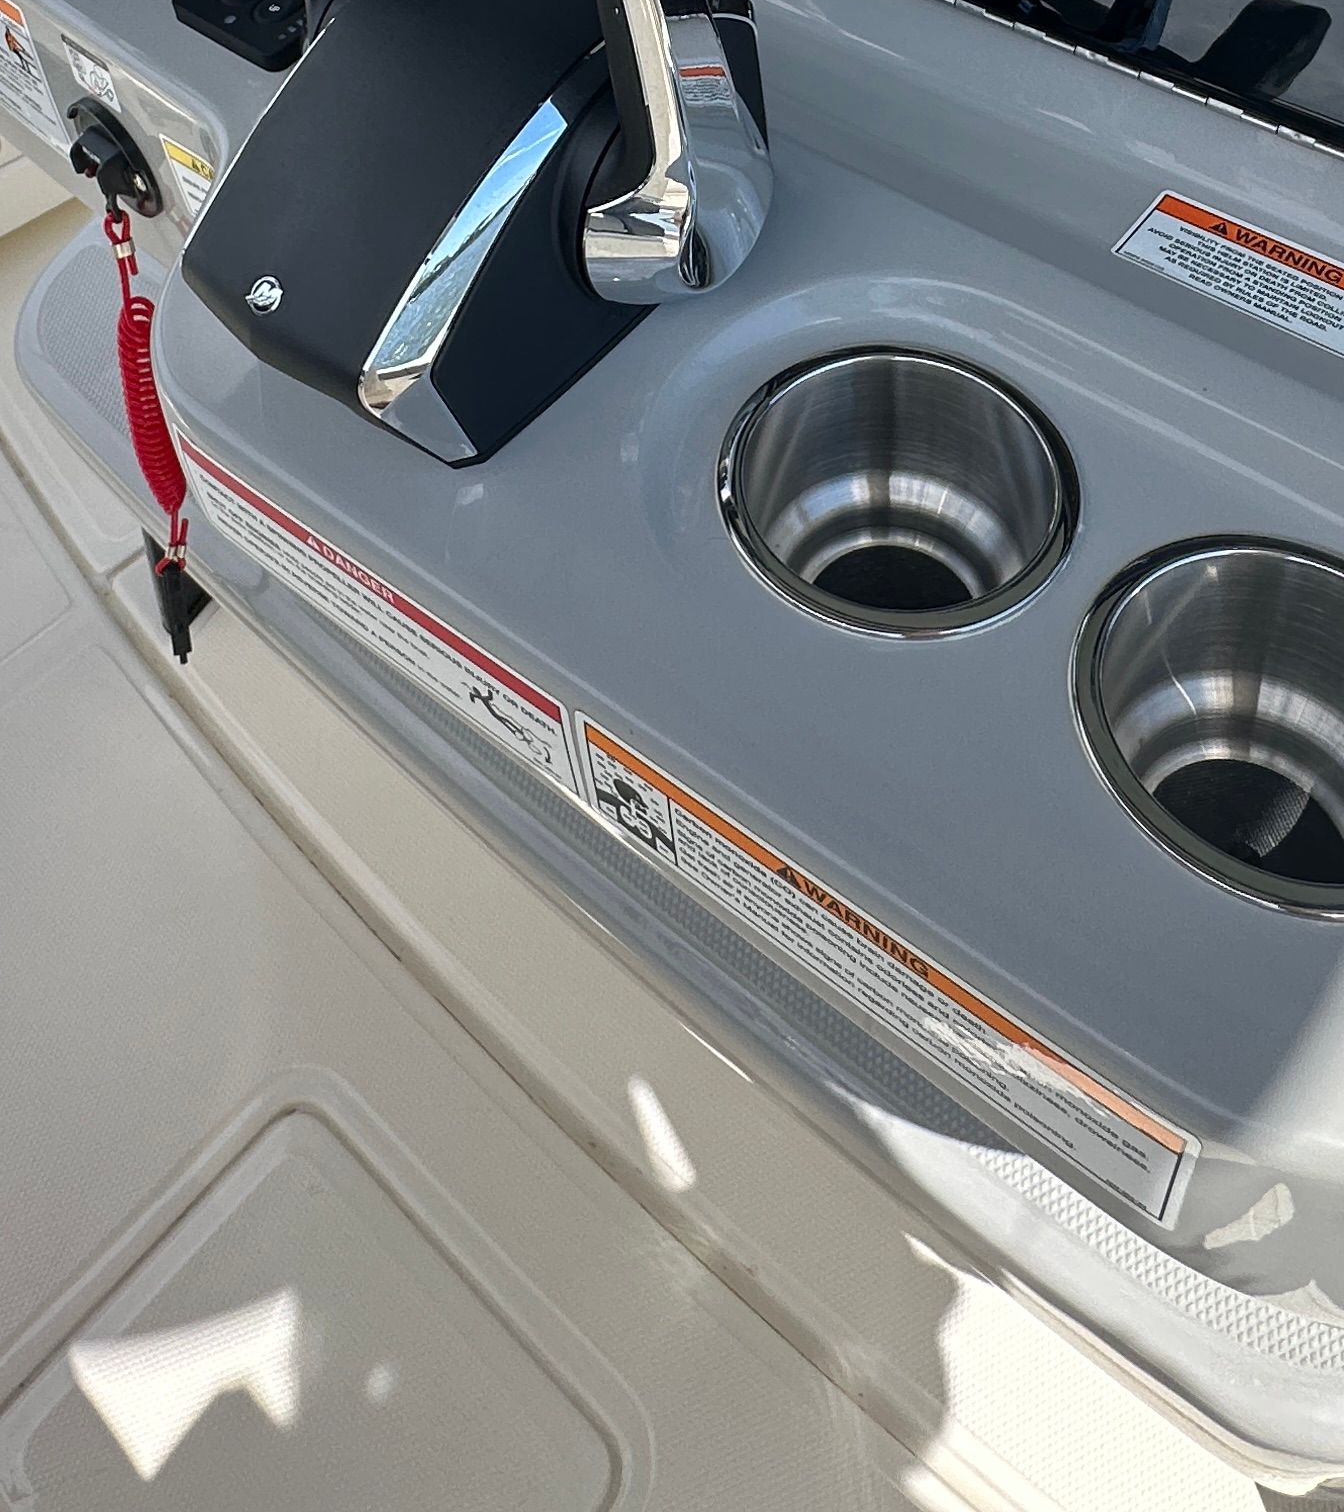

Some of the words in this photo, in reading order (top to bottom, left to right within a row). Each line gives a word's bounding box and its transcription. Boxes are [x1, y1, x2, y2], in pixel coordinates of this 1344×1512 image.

[1147, 226, 1174, 240] AVOID
[1211, 254, 1243, 271] INJURY
[1258, 275, 1288, 291] DEATH
[1288, 288, 1315, 303] FROM
[1167, 242, 1217, 267] OPERATION
[1217, 264, 1244, 278] FROM
[1251, 279, 1297, 302] STANDING
[1297, 299, 1342, 322] POSITION
[1187, 273, 1213, 287] READ
[1189, 259, 1242, 285] NECESSARY
[1242, 282, 1255, 291] TO
[1196, 240, 1216, 252] THIS
[1216, 249, 1242, 263] HELM
[1241, 260, 1279, 279] STATION
[1232, 229, 1344, 283] WARNING
[1299, 278, 1343, 300] POSITION
[1221, 281, 1234, 289] BY
[1279, 307, 1298, 318] THE
[320, 542, 395, 605] DANGER
[674, 807, 711, 839] Carbon
[715, 836, 766, 878] monoxide
[770, 875, 795, 899] (CO)
[857, 937, 884, 962] brain
[887, 959, 933, 998] damage
[937, 995, 948, 1008] or
[677, 828, 702, 852] Signs
[705, 848, 714, 861] of
[717, 857, 750, 887] carbon
[753, 883, 802, 924] monoxide
[806, 922, 856, 964] poisoning
[860, 960, 898, 993] include
[679, 845, 695, 862] Get
[697, 859, 720, 880] fresh
[781, 920, 812, 948] shows
[815, 945, 841, 970] signs
[804, 879, 929, 979] WARNING
[675, 817, 709, 847] Engine
[712, 843, 730, 862] and
[734, 859, 780, 899] generator
[784, 896, 824, 930] exhaust
[828, 927, 872, 965] contains
[876, 962, 924, 1001] odorless
[927, 999, 948, 1019] and
[1055, 1090, 1118, 1140] monoxide
[681, 855, 698, 873] See
[743, 901, 778, 932] Manual
[781, 929, 793, 943] for
[797, 941, 854, 988] information
[858, 986, 908, 1029] regarding
[911, 1025, 951, 1059] carbon
[954, 1057, 1011, 1103] monoxide
